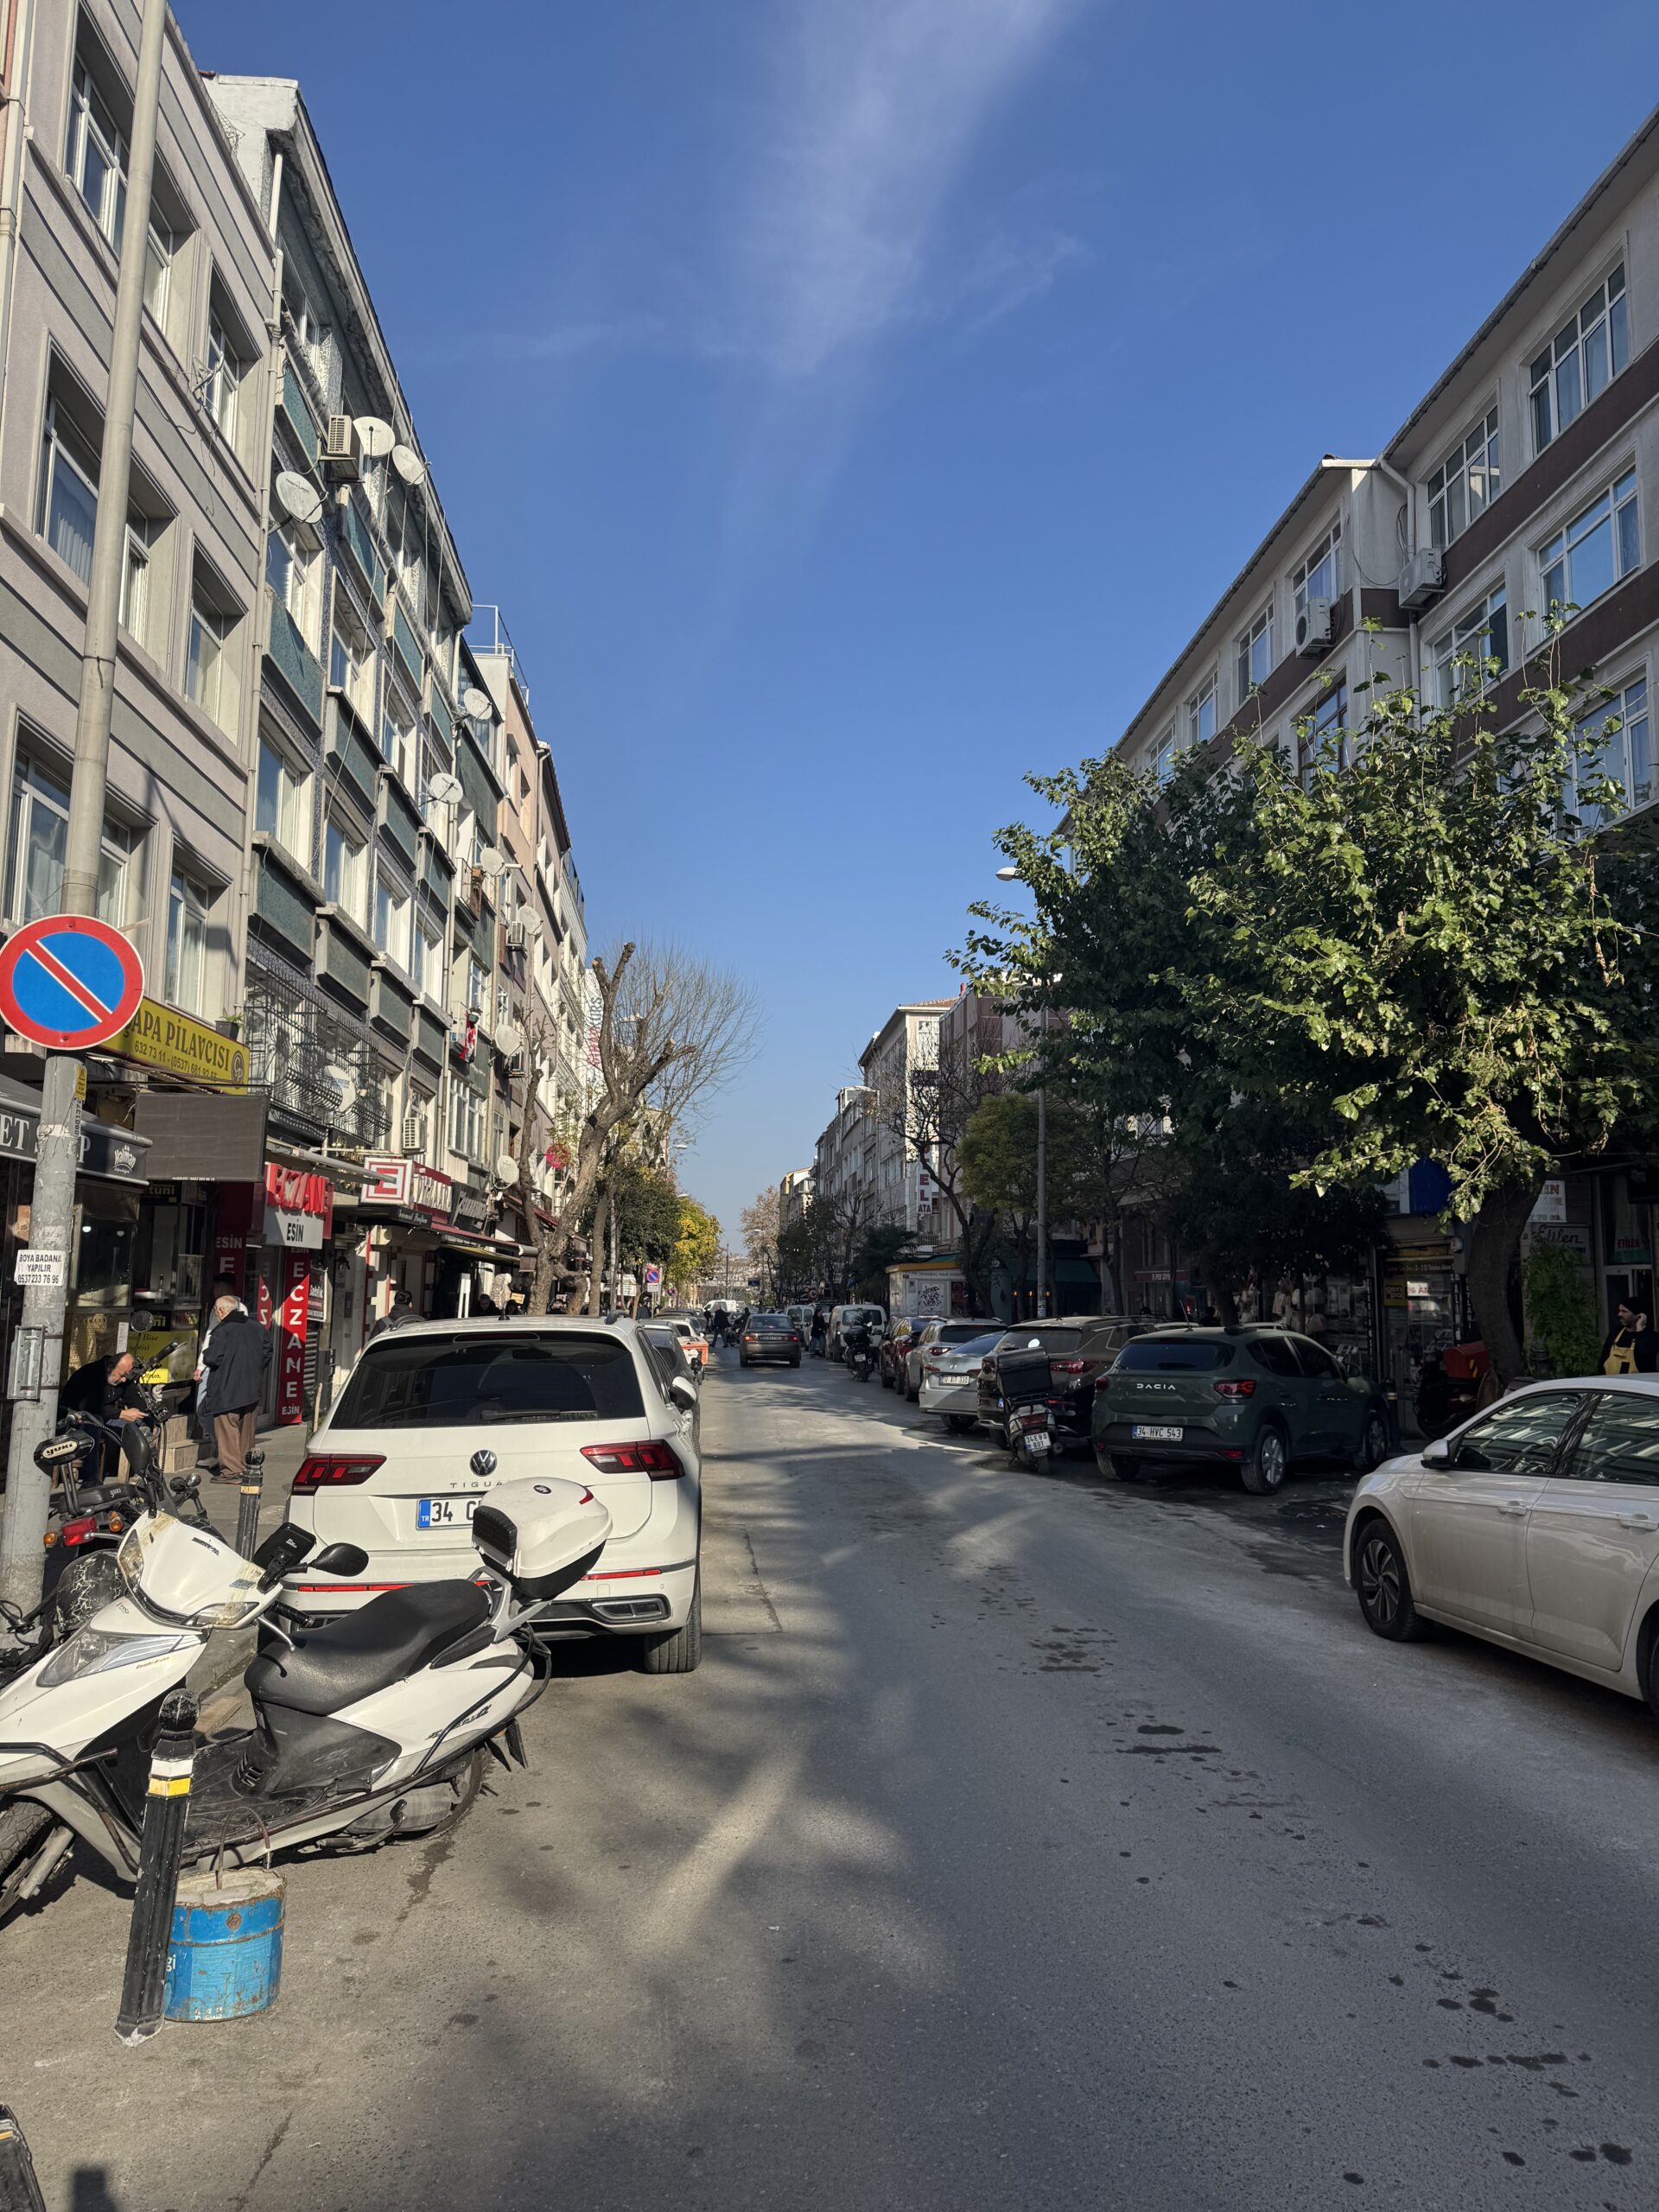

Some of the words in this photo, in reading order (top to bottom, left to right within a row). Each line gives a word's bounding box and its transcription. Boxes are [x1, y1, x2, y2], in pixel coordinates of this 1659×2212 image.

[124, 1008, 162, 1044] APA
[165, 1018, 230, 1072] PİLAVCISI
[134, 1040, 148, 1055] 632
[149, 1046, 157, 1059] 73
[158, 1050, 167, 1063] 11
[171, 1055, 190, 1074] (0537)
[918, 1204, 931, 1213] ATA
[286, 1218, 304, 1243] ESİN
[19, 1254, 35, 1262] BOYA
[35, 1254, 62, 1263] BADANA
[27, 1264, 52, 1273] YAPILIR
[17, 1274, 32, 1284] 0537
[31, 1274, 42, 1284] 233
[286, 1262, 305, 1398] ECZANE
[1137, 1427, 1146, 1436] 34
[1149, 1427, 1164, 1437] HVC
[1166, 1428, 1181, 1439] 543
[431, 1502, 454, 1522] 34
